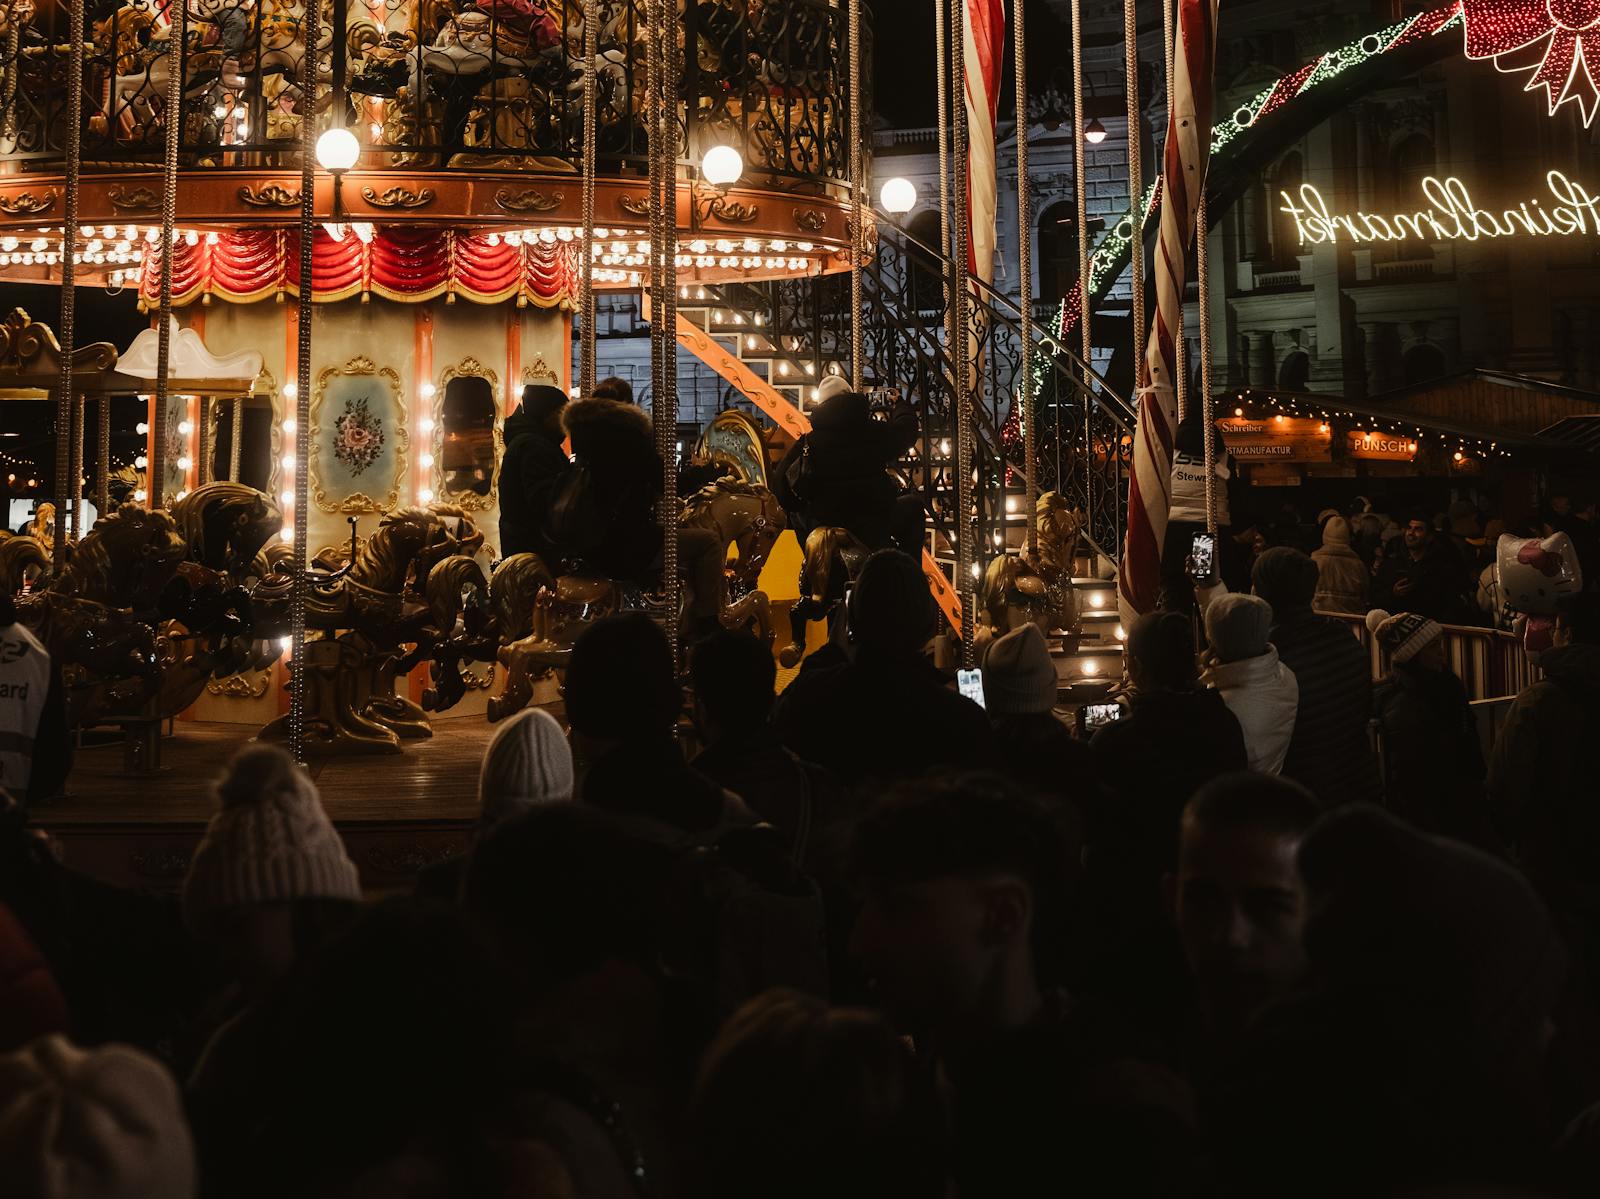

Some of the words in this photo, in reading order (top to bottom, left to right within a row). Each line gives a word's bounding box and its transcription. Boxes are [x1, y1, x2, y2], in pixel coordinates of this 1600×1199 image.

[1222, 421, 1263, 433] Schreiber
[1354, 439, 1407, 453] PUNSCH
[0, 682, 29, 700] ard
